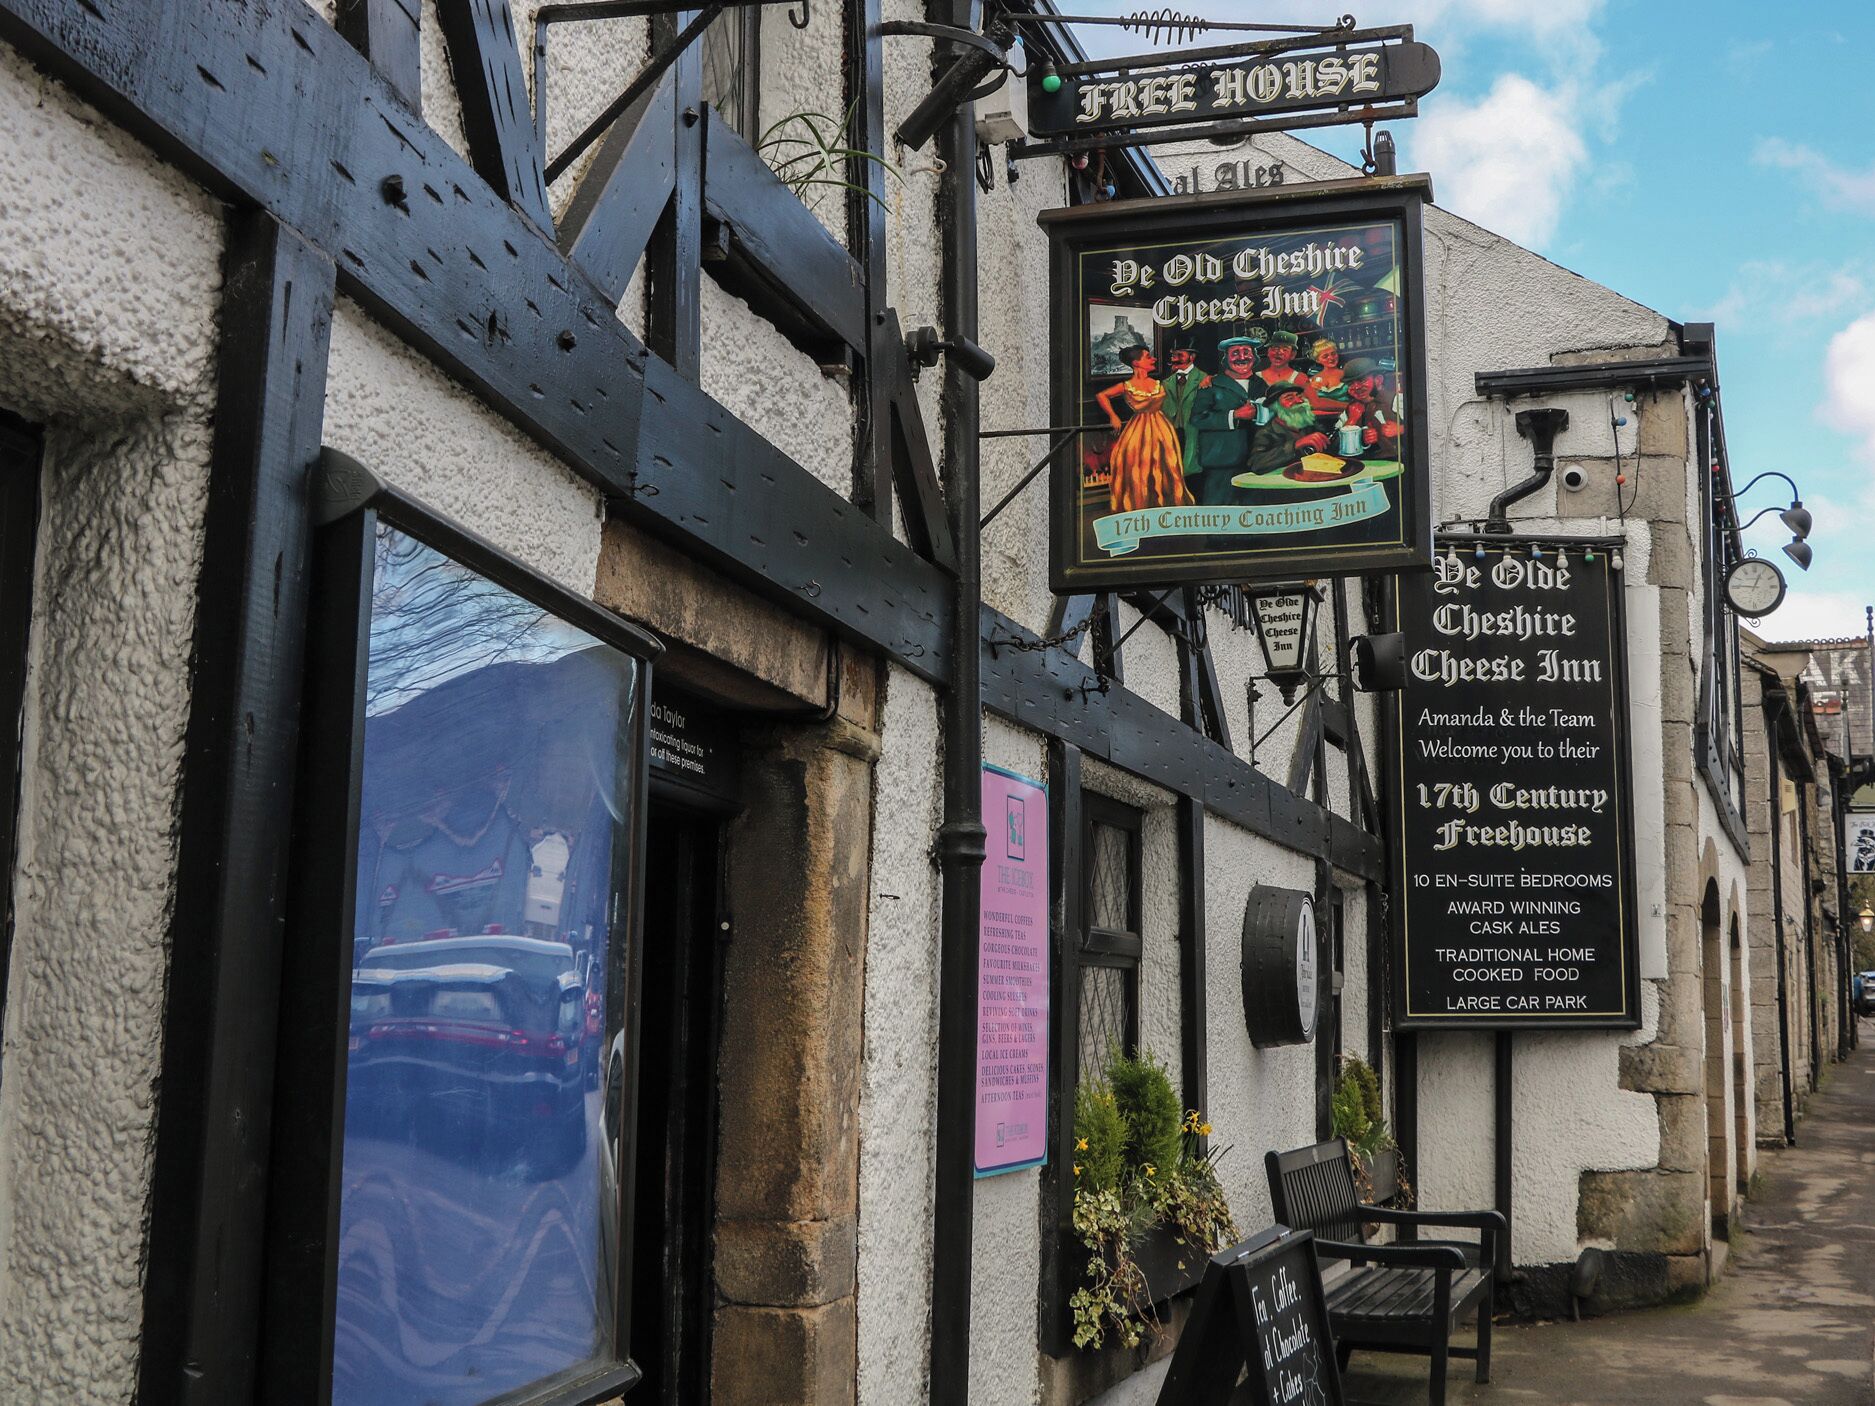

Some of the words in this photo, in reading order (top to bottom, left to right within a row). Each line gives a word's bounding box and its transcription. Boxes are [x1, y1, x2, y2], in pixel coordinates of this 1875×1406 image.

[1075, 73, 1198, 123] FREE
[1210, 52, 1380, 108] HOUSE
[1165, 165, 1203, 195] al
[1214, 159, 1285, 192] Ales
[1111, 260, 1155, 296] Ye
[1163, 253, 1224, 287] Old
[1232, 241, 1365, 280] Cheshire
[1152, 293, 1256, 330] Cheese
[1260, 285, 1323, 319] Inn
[1114, 514, 1150, 536] 17th
[1158, 511, 1231, 530] Century
[1238, 507, 1324, 527] Coaching
[1330, 500, 1367, 520] Inn
[1434, 555, 1482, 595] Ye
[1491, 558, 1572, 590] Olde
[1259, 599, 1273, 611] Ye
[1275, 596, 1299, 608] Olde
[1260, 612, 1301, 624] Cheshire
[1433, 603, 1576, 641] Cheshire
[1265, 627, 1298, 638] Cheese
[1273, 641, 1293, 652] Inn
[1411, 649, 1525, 687] Cheese
[1537, 650, 1602, 682] Inn
[663, 705, 686, 728] Taylor
[1418, 705, 1495, 726] Amanda
[1499, 708, 1515, 726] &
[1518, 706, 1546, 727] the
[1549, 709, 1596, 727] Team
[1418, 737, 1498, 758] Welcome
[1501, 744, 1533, 764] you
[1537, 741, 1554, 758] to
[1558, 738, 1600, 758] their
[1417, 782, 1480, 813] 17th
[1490, 782, 1608, 813] Century
[1433, 818, 1592, 851] Freehouse
[1413, 875, 1430, 887] 10
[1435, 875, 1515, 887] EN-SUITE
[1521, 875, 1613, 887] BEDROOMS
[1447, 902, 1505, 914] AWARD
[1510, 902, 1581, 914] WINNING
[1470, 922, 1513, 935] CASK
[1519, 921, 1560, 934] ALES
[1435, 949, 1543, 962] TRADITIONAL
[1548, 948, 1595, 961] HOME
[1453, 968, 1523, 982] COOKED
[1534, 968, 1579, 981] FOOD
[1447, 996, 1501, 1010] LARGE
[1506, 996, 1540, 1009] CAR
[1545, 996, 1587, 1009] PARK
[1272, 1312, 1310, 1362] Chocolate
[1280, 1370, 1303, 1403] Cakes
